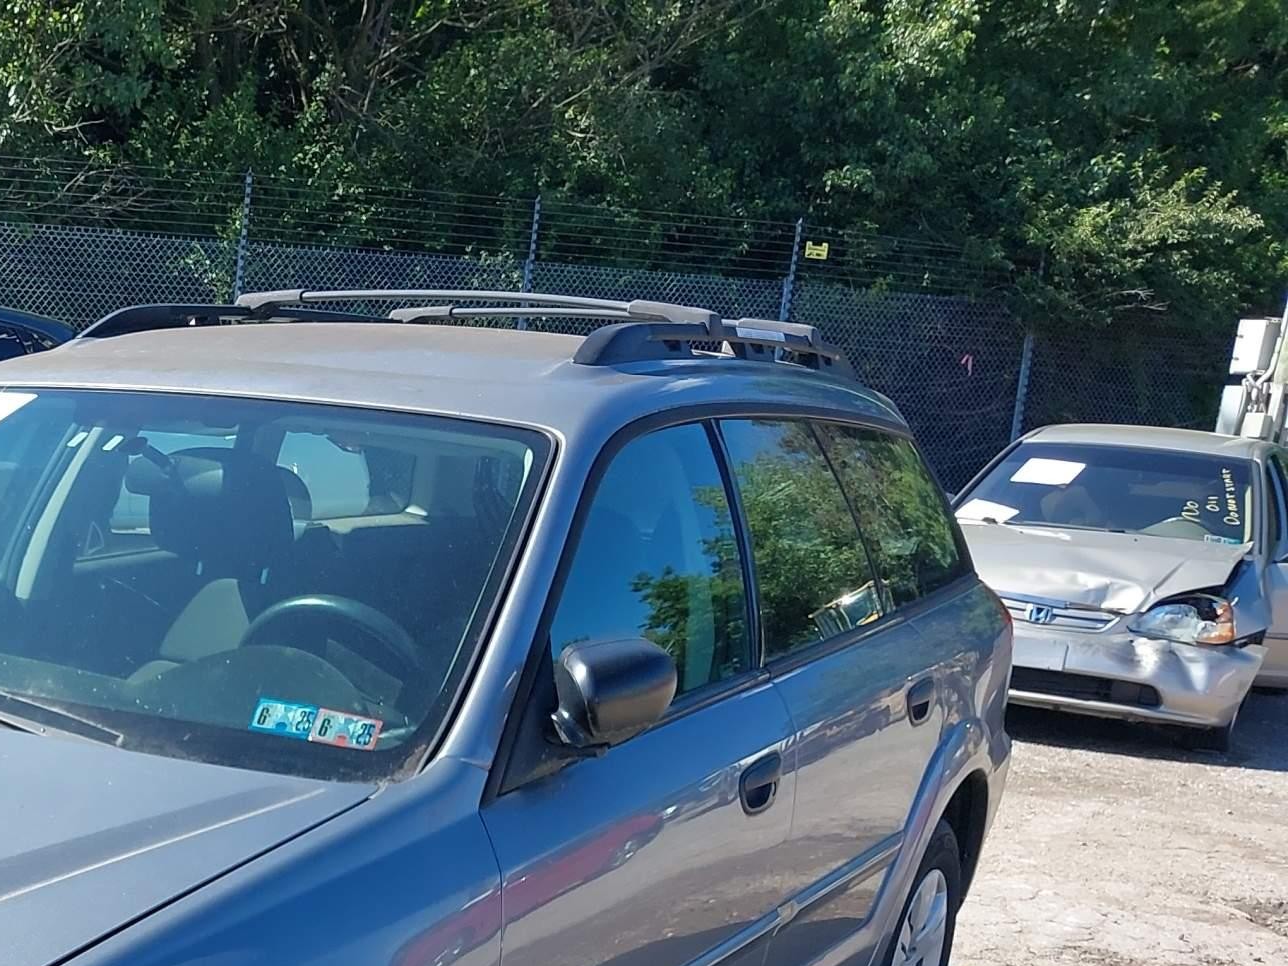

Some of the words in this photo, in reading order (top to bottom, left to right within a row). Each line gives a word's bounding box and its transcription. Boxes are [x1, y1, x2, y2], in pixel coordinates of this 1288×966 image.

[257, 707, 269, 726] 6
[295, 709, 315, 732] 25
[318, 718, 331, 737] 6
[355, 723, 376, 746] 25
